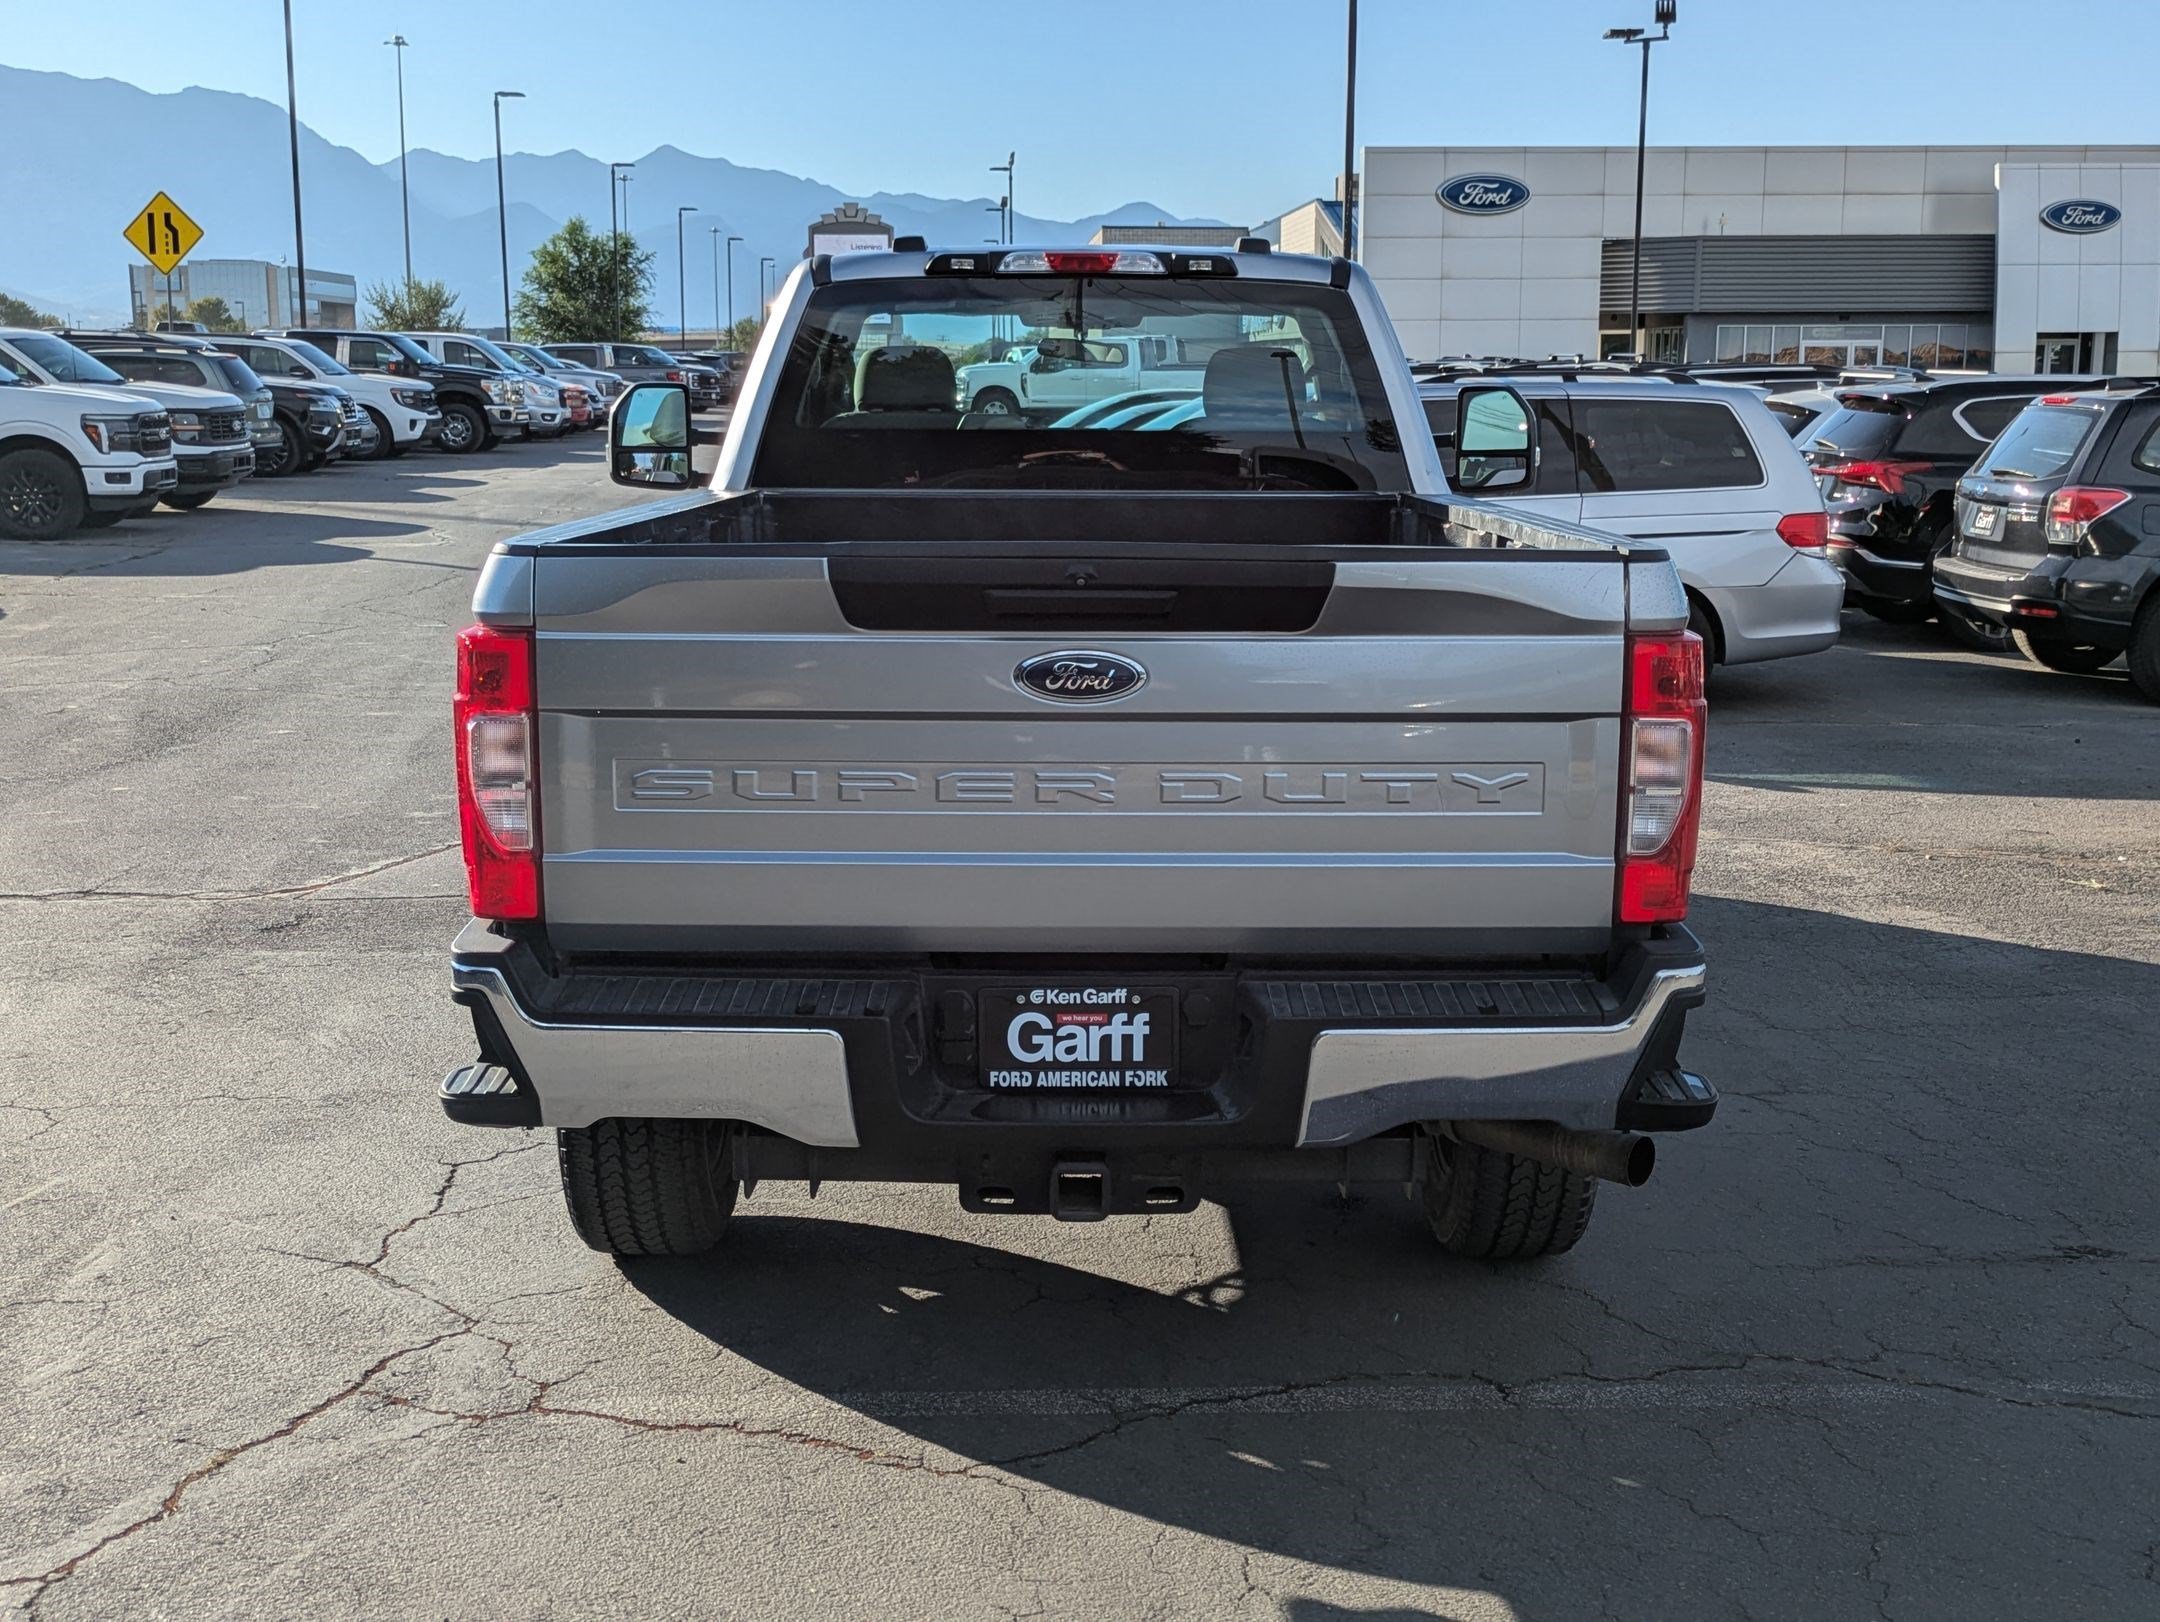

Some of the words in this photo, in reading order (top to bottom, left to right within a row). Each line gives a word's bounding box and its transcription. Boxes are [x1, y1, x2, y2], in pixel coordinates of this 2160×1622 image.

[1459, 182, 1512, 205] Ford
[2061, 206, 2106, 225] Ford
[1045, 661, 1115, 690] Ford
[633, 769, 1115, 803] SUPER
[1160, 772, 1529, 804] DUTY
[1046, 989, 1081, 1004] Ken
[1083, 988, 1128, 1004] Garff
[1007, 1011, 1150, 1063] Garff
[989, 1071, 1032, 1087] FORD
[1036, 1071, 1120, 1087] AMERICAN
[1125, 1071, 1168, 1087] FORK
